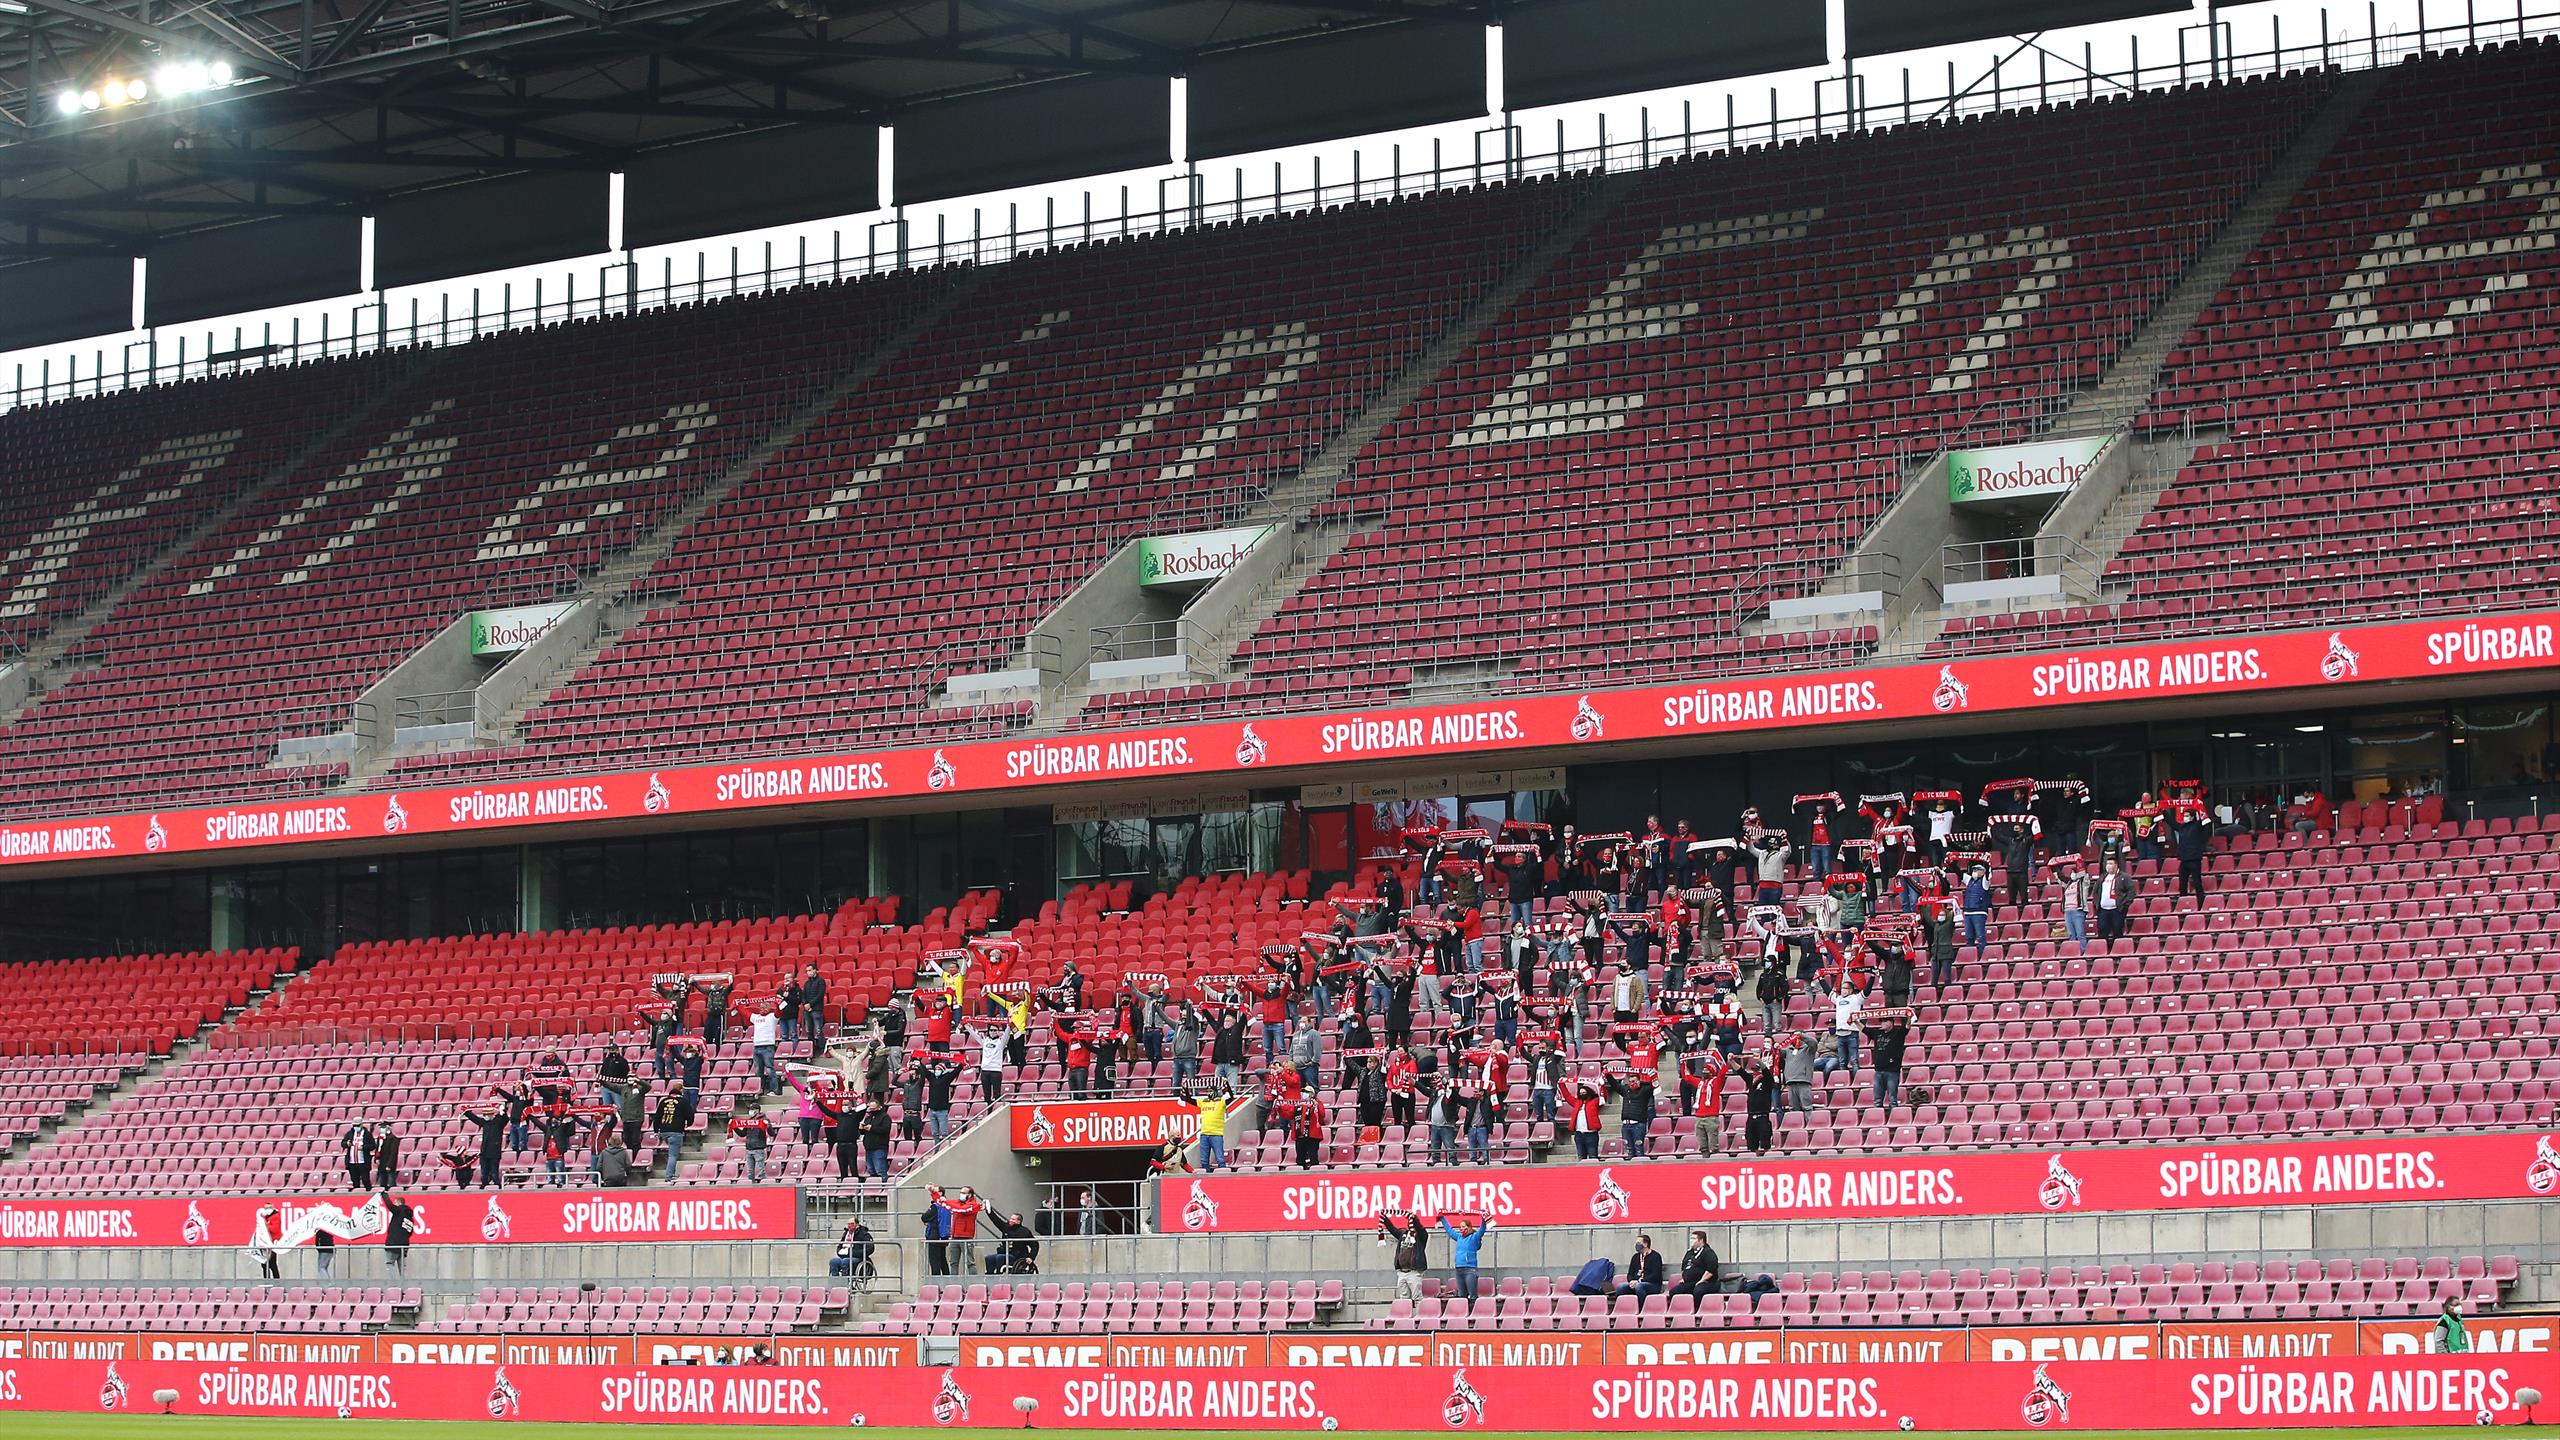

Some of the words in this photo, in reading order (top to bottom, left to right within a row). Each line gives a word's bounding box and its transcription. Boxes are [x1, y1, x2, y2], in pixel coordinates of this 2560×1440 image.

[1976, 456, 2093, 493] Rosbache
[2427, 624, 2554, 666] SPÜRBAR
[2032, 656, 2151, 697] SPÜRBAR
[2158, 648, 2268, 687] ANDERS.
[1663, 688, 1774, 727] SPÜRBAR
[1781, 680, 1883, 718] ANDERS.
[1321, 717, 1424, 754] SPÜRBAR
[1430, 710, 1525, 745] ANDERS.
[1006, 743, 1101, 778] SPÜRBAR
[1106, 736, 1194, 770] ANDERS.
[716, 767, 803, 801] SPÜRBAR
[808, 762, 889, 794] ANDERS.
[449, 790, 530, 823] SPÜRBAR
[534, 784, 608, 816] ANDERS.
[0, 828, 50, 858] ÜRBAR
[52, 825, 116, 854] ANDERS.
[205, 810, 279, 842] SPÜRBAR
[282, 806, 351, 836] ANDERS.
[1527, 1031, 1536, 1039] FC
[1063, 1112, 1151, 1143] SPÜRBAR
[1701, 1167, 1833, 1211] SPÜRBAR
[1841, 1168, 1963, 1207] ANDERS.
[2159, 1152, 2303, 1198] SPÜRBAR
[2312, 1151, 2445, 1193] ANDERS.
[563, 1196, 661, 1234] SPÜRBAR
[666, 1199, 758, 1232] ANDERS.
[1283, 1179, 1402, 1221] SPÜRBAR
[1411, 1181, 1521, 1218] ANDERS.
[0, 1205, 59, 1239] ÜRBAR
[63, 1209, 138, 1238] ANDERS.
[153, 1342, 248, 1362] REWE
[392, 1343, 497, 1364] REWE
[975, 1346, 1101, 1367] REWE
[1288, 1345, 1424, 1367] REWE
[1625, 1341, 1773, 1366] REWE
[1991, 1336, 2149, 1362] REWE
[198, 1366, 298, 1407] SPÜRBAR
[303, 1374, 397, 1409] ANDERS.
[601, 1370, 715, 1413] SPÜRBAR
[722, 1378, 829, 1415] ANDERS.
[1063, 1372, 1194, 1418] SPÜRBAR
[1202, 1380, 1324, 1419] ANDERS.
[1591, 1371, 1739, 1419] SPÜRBAR
[1749, 1377, 1887, 1418] ANDERS.
[2190, 1364, 2355, 1416] SPÜRBAR
[2367, 1369, 2520, 1413] ANDERS.
